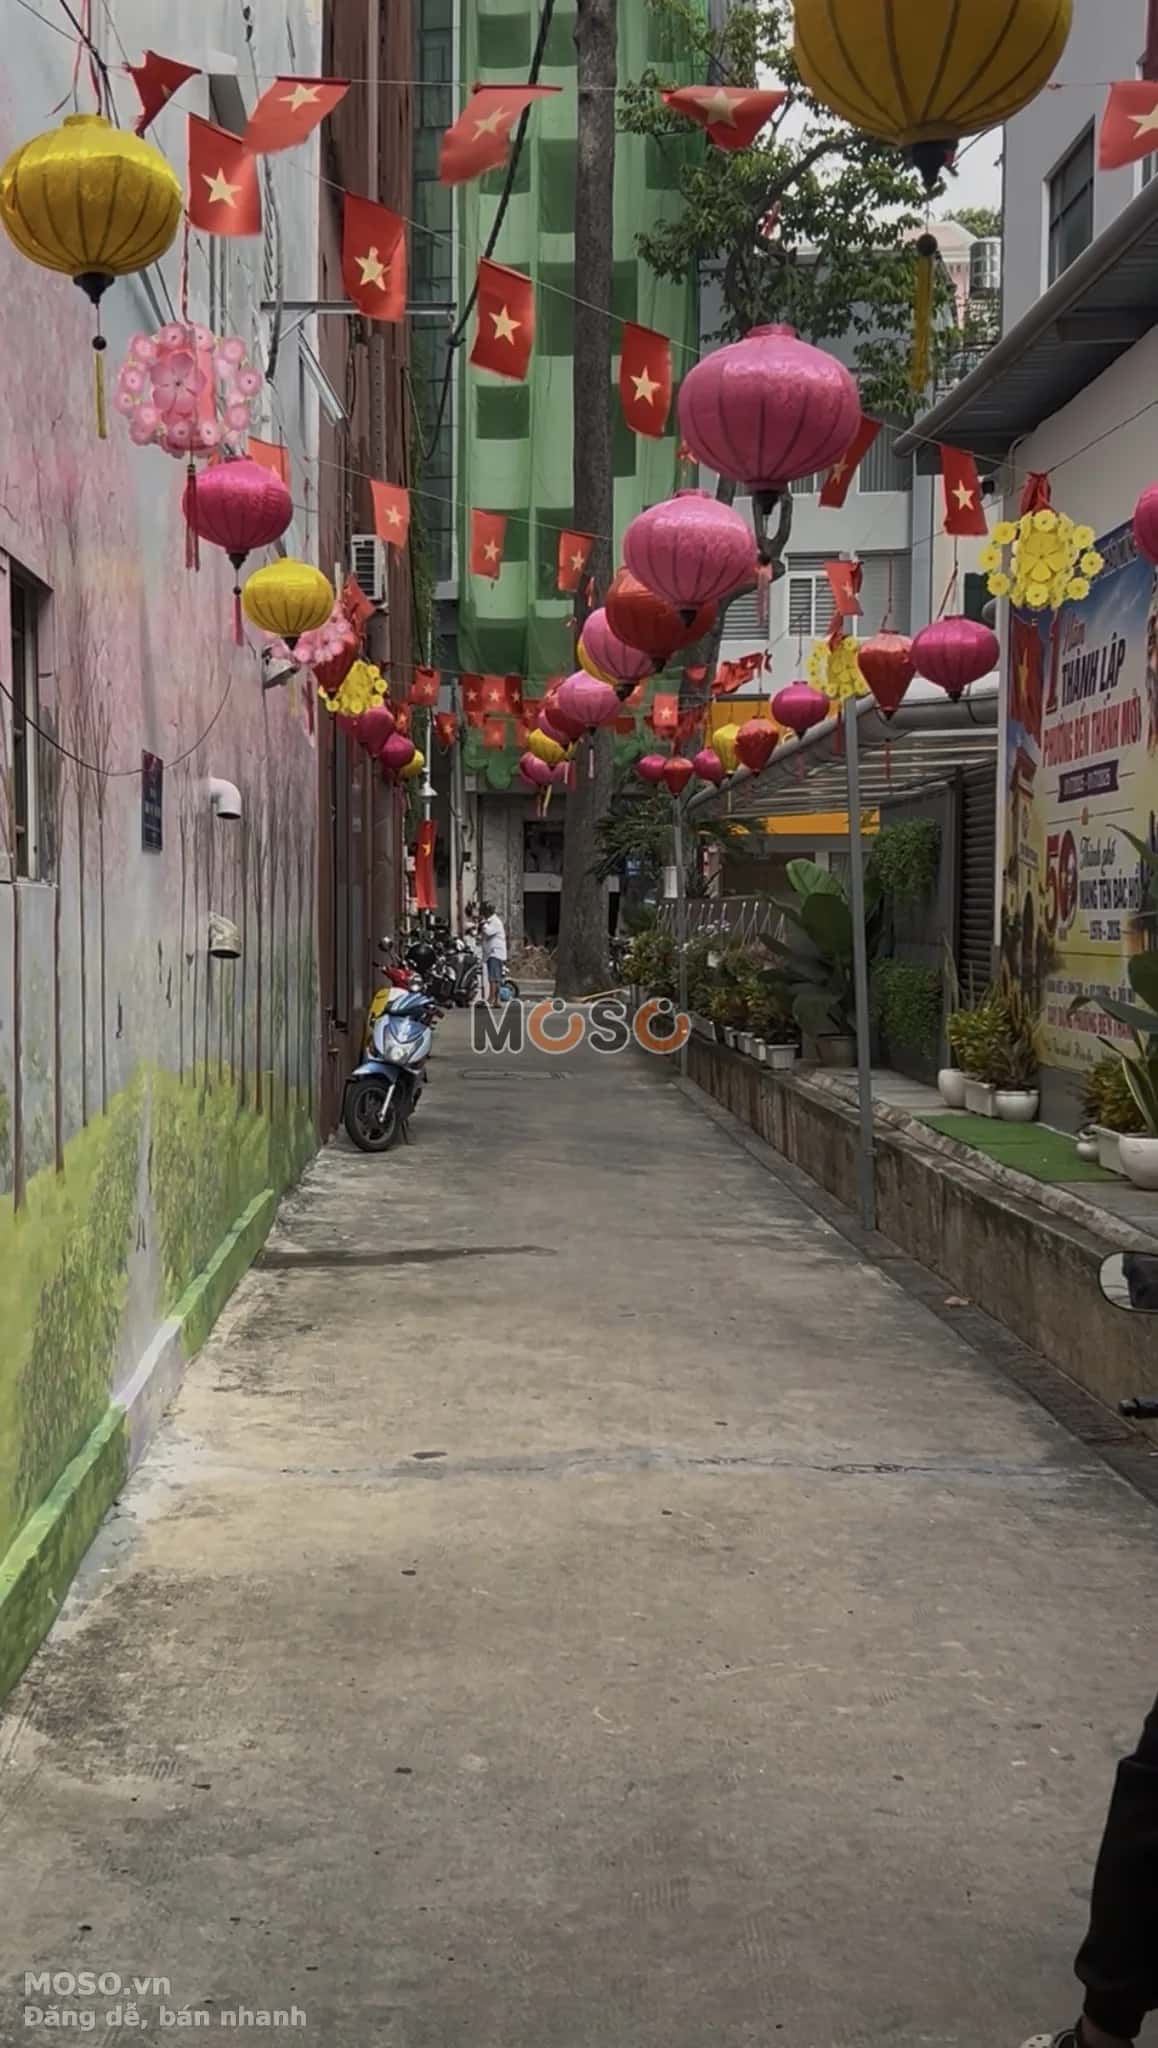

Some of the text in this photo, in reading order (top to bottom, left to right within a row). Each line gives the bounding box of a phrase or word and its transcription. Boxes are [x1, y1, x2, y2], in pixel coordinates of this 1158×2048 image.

[1062, 632, 1126, 707] THÀNH LẬP
[1074, 702, 1090, 761] BẾN
[1113, 868, 1128, 910] BÁC
